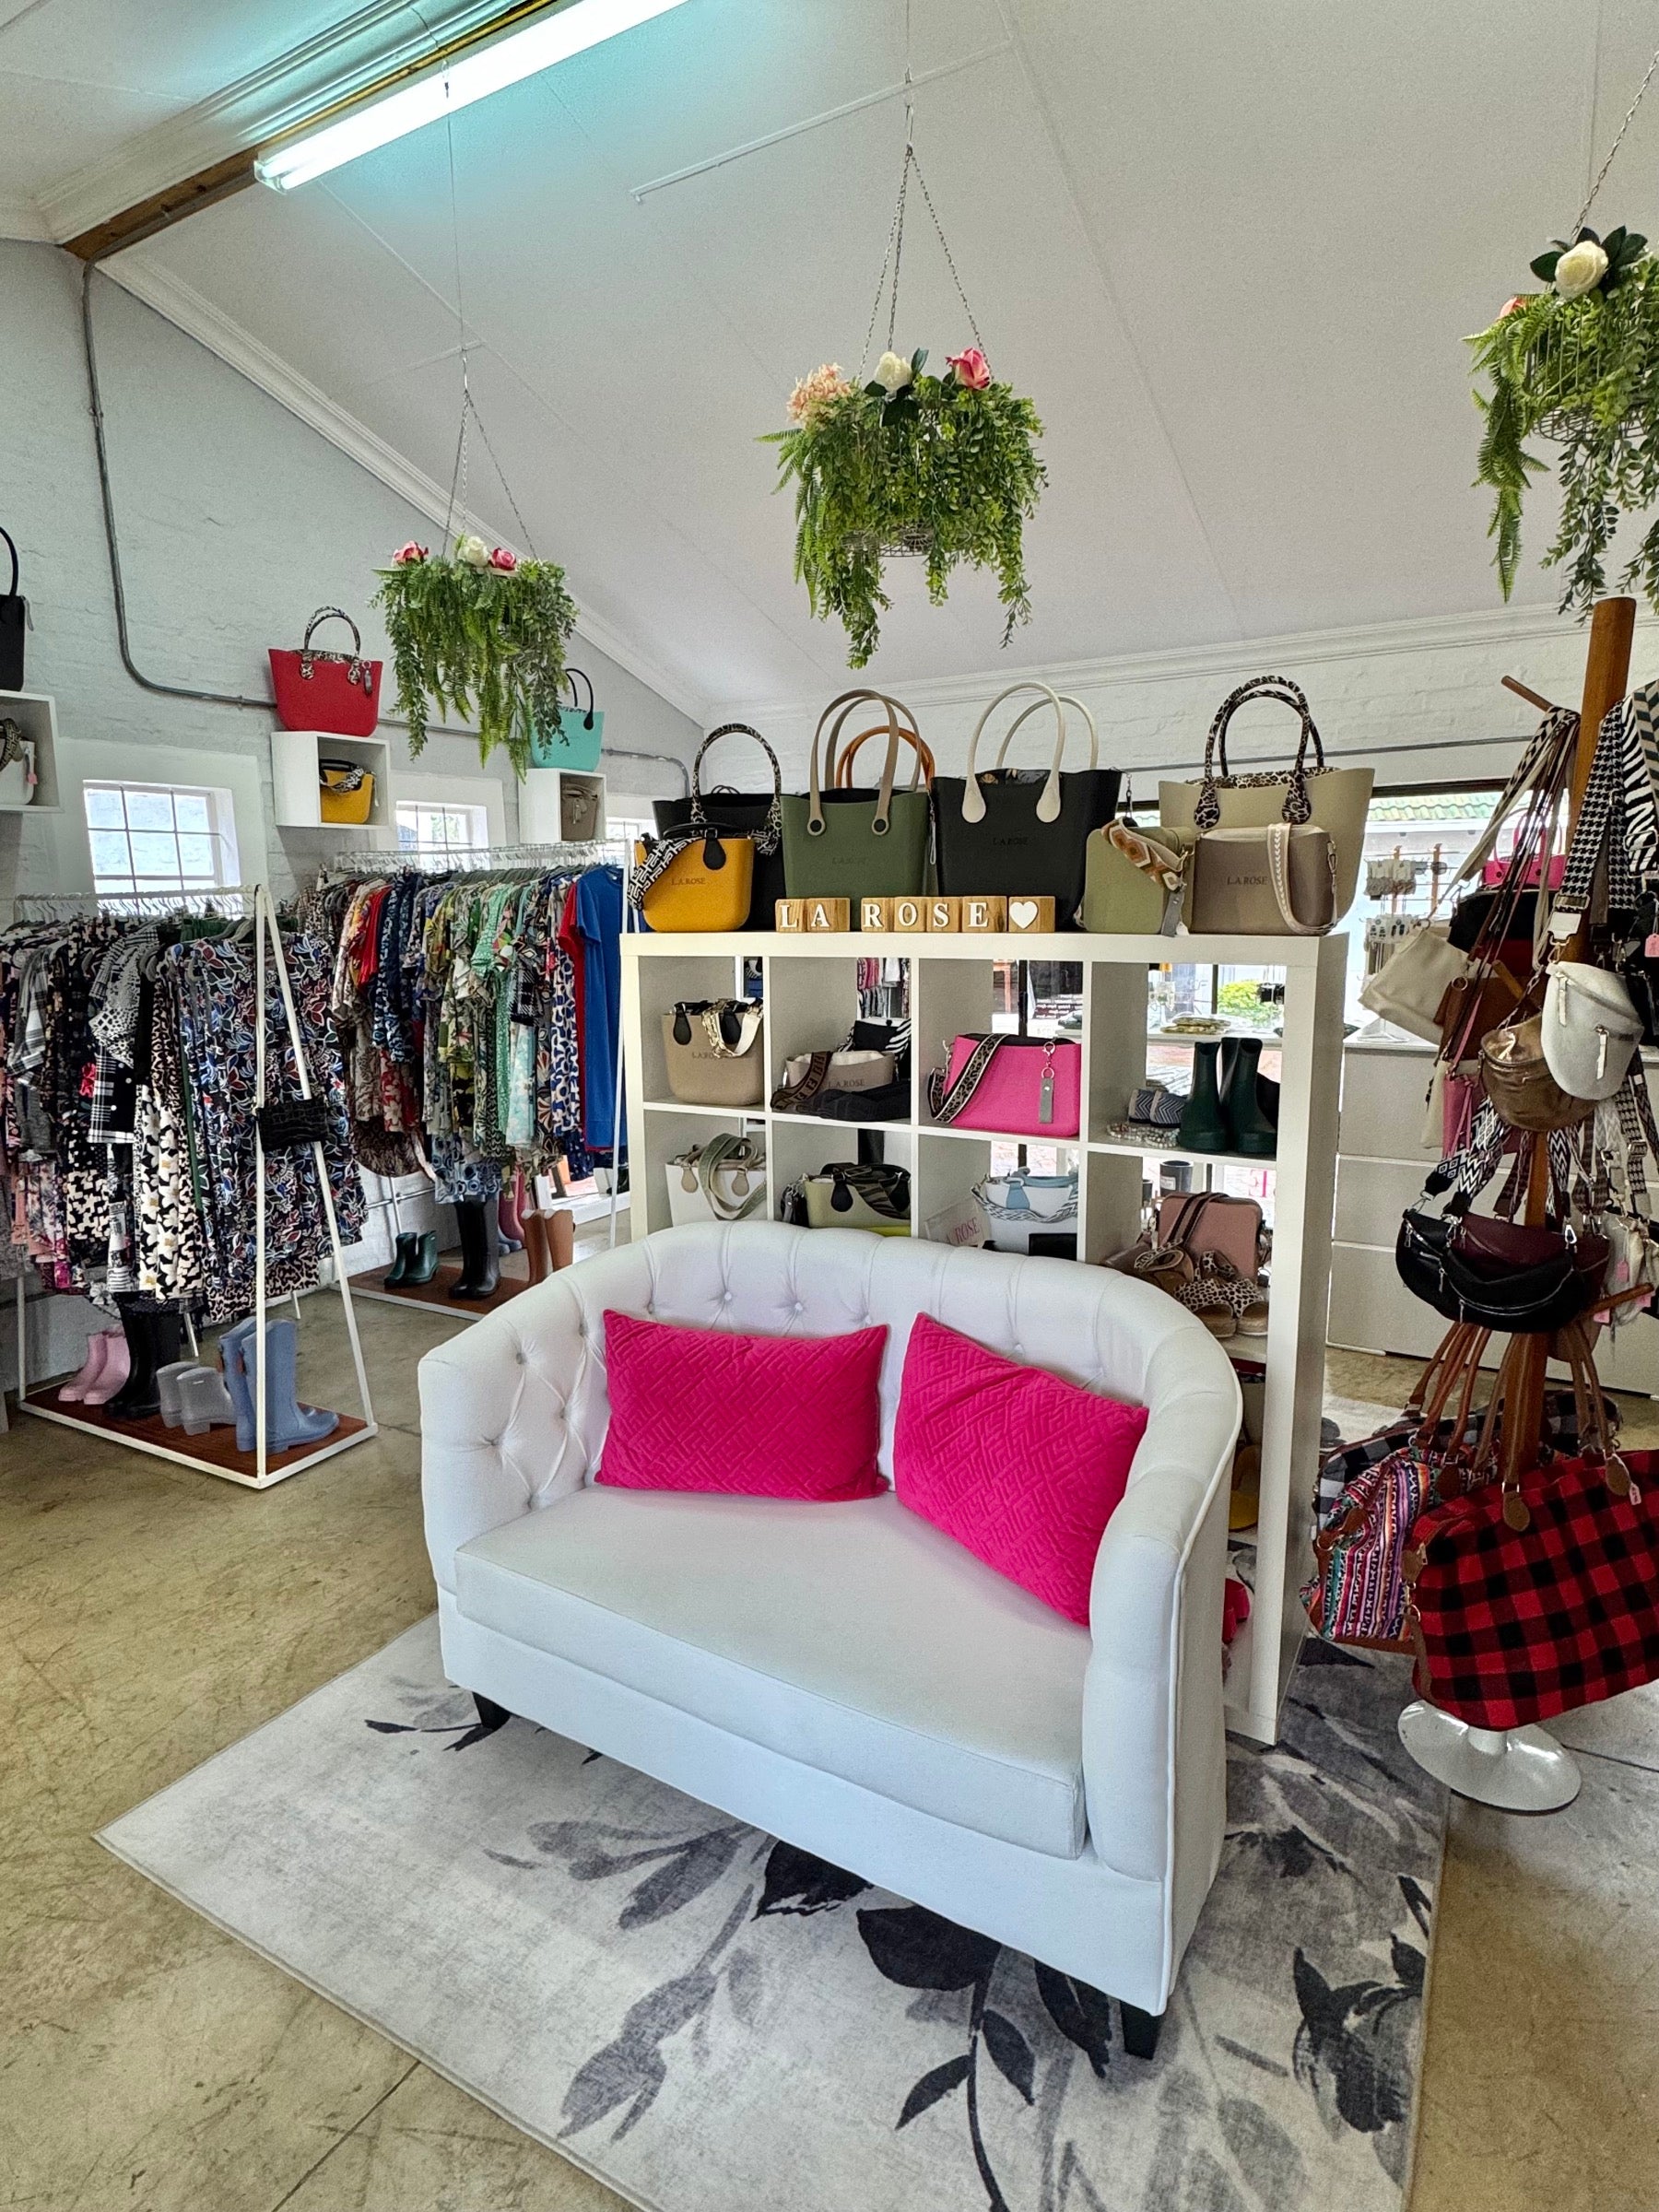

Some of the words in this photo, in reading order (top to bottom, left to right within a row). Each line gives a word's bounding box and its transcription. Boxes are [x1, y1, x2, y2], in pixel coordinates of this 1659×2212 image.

[779, 903, 830, 929] LA
[863, 901, 989, 929] ROSE
[954, 1217, 980, 1244] ROSE
